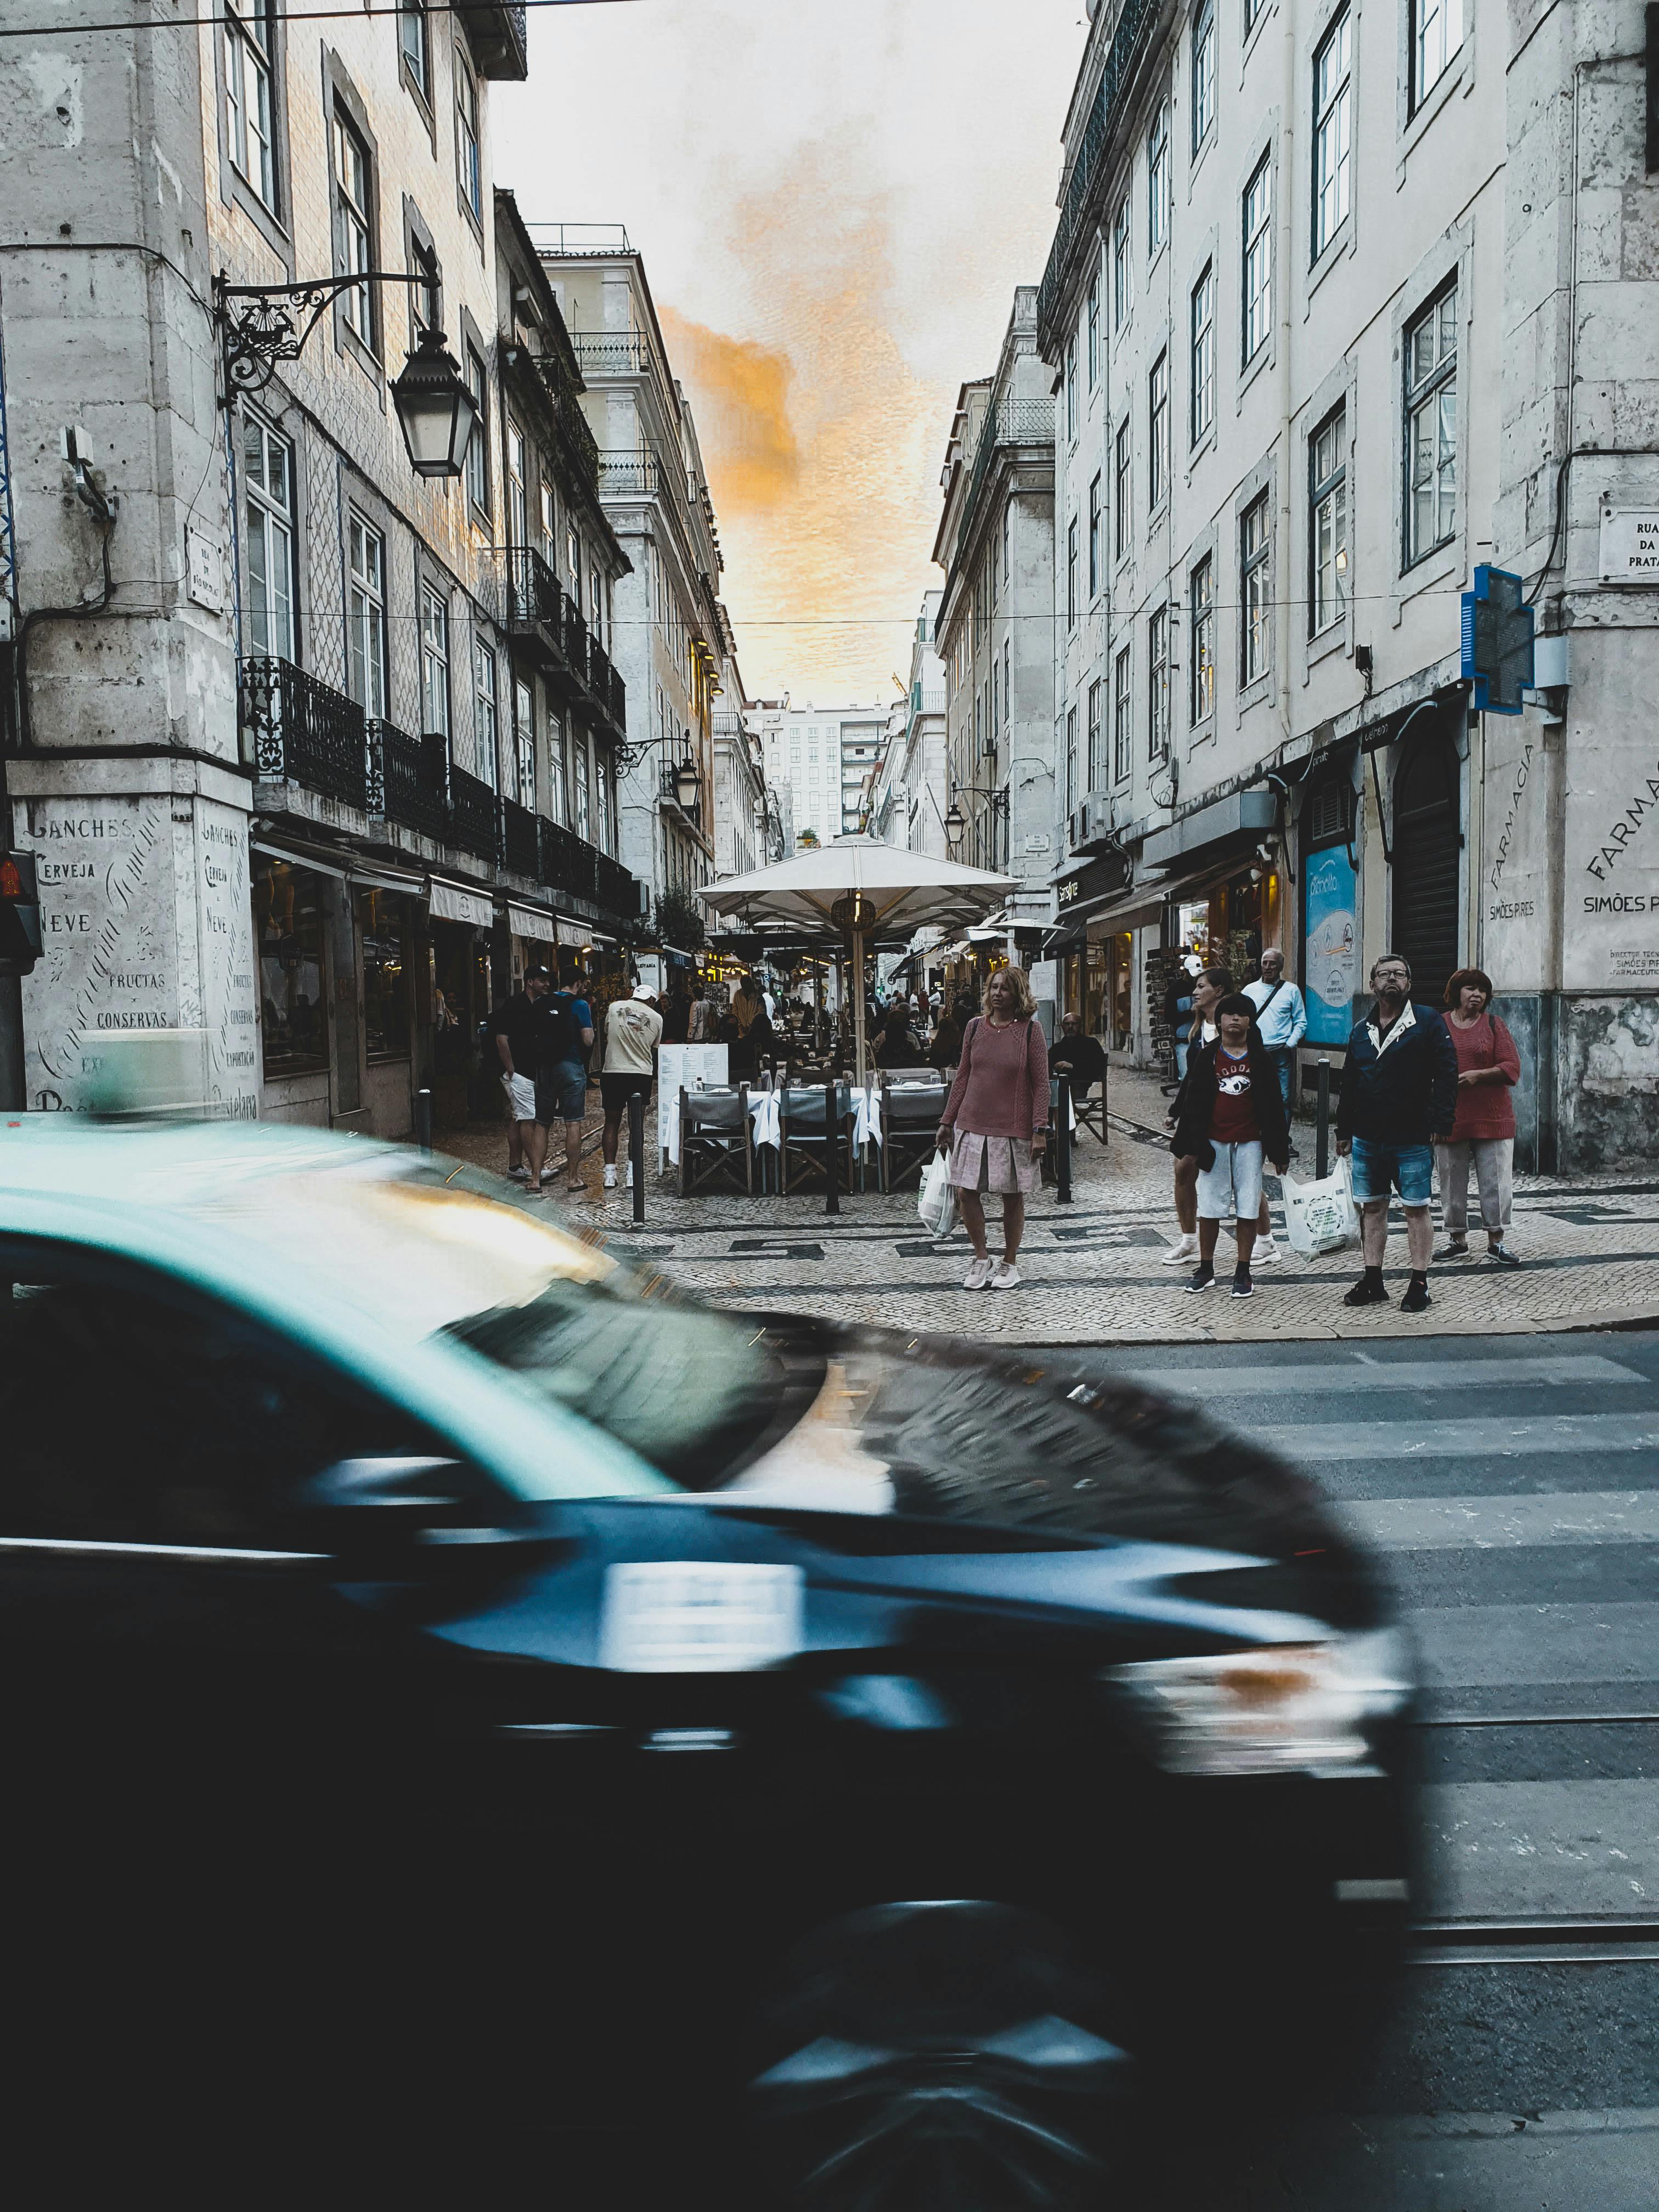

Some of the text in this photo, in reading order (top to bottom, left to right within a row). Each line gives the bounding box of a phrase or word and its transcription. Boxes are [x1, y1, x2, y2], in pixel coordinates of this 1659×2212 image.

[1637, 524, 1659, 533] RUA
[1640, 540, 1655, 550] DA
[1491, 744, 1533, 891] FARMACIA
[1586, 759, 1659, 881] FARMA
[1584, 893, 1646, 912] SIMÕES
[97, 1012, 167, 1029] CONSERVAS
